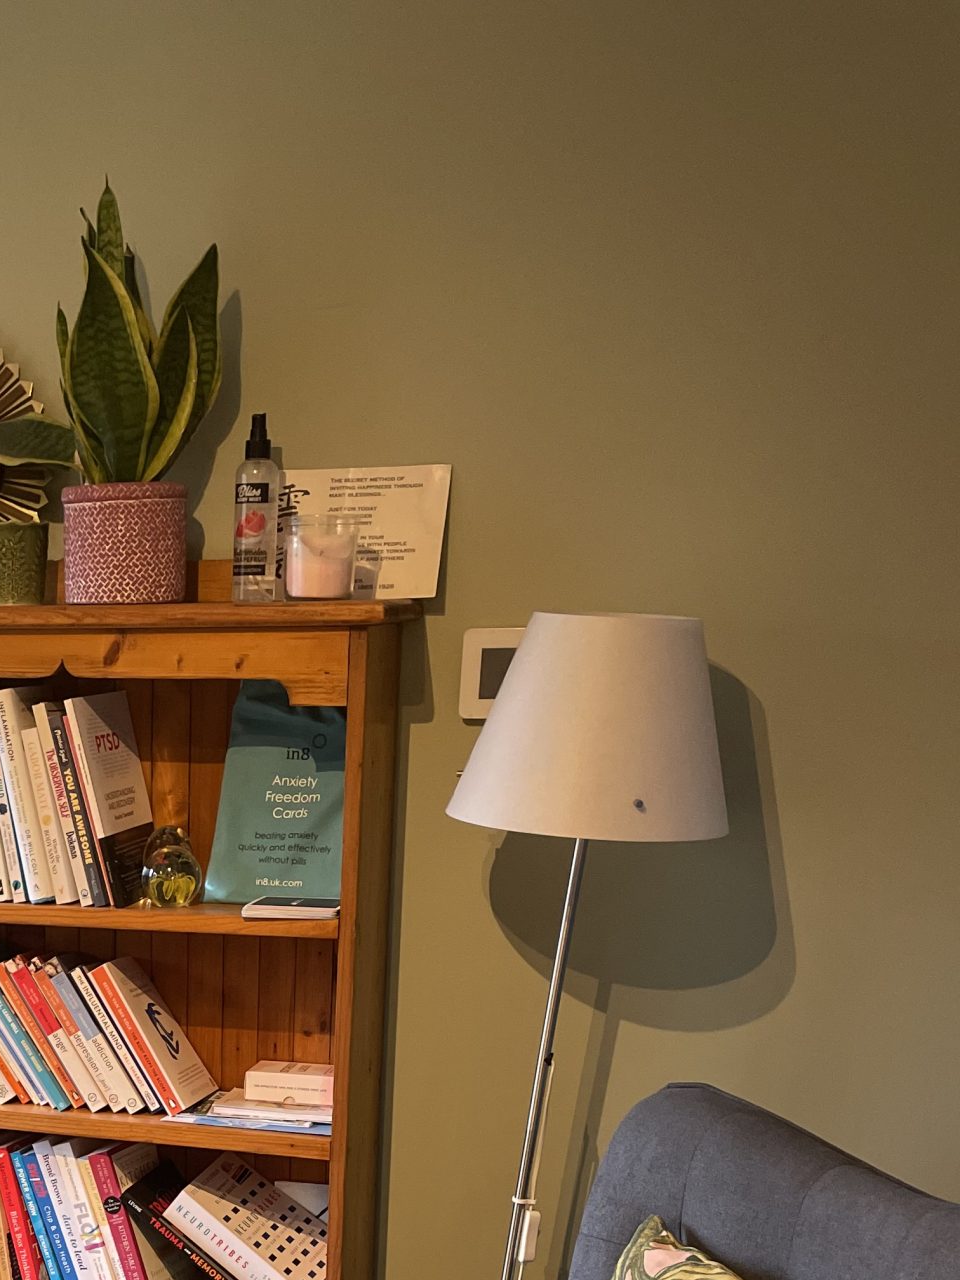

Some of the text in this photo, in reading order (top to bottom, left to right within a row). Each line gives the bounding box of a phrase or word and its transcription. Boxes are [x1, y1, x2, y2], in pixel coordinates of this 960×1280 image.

[95, 732, 120, 753] PTSD
[286, 747, 310, 760] in8
[47, 761, 66, 802] OBSERVING
[57, 800, 71, 819] SELF
[62, 767, 75, 790] YOU
[272, 775, 318, 790] Anxiety
[68, 791, 80, 812] ARE
[265, 791, 321, 804] Freedom
[272, 808, 308, 819] Cards
[72, 812, 94, 865] AWESOME
[255, 832, 286, 841] beating
[238, 844, 332, 855] quickly and effectively
[259, 856, 307, 866] without pills
[30, 857, 39, 876] COLE
[255, 878, 303, 887] in8.uk.com
[76, 974, 123, 1051] THE INFLUENTIAL MIND
[50, 1031, 68, 1054] anger
[71, 1032, 100, 1073] depression
[91, 1036, 115, 1071] addiction
[41, 1153, 55, 1178] Brené
[16, 1167, 29, 1192] POWER
[27, 1200, 37, 1217] NOW
[49, 1178, 64, 1205] Brown
[9, 1210, 20, 1232] Black
[61, 1212, 76, 1237] dare
[72, 1201, 105, 1255] FLOW
[14, 1232, 24, 1248] Box
[42, 1204, 55, 1225] Chip
[52, 1232, 63, 1249] Dan
[58, 1250, 71, 1274] Heath
[69, 1237, 79, 1249] to
[147, 1216, 186, 1250] TRAUMA
[175, 1204, 249, 1270] NEUROTRIBES
[117, 1224, 131, 1251] KITCHEN
[126, 1252, 136, 1270] TABLE
[73, 1248, 87, 1272] lead
